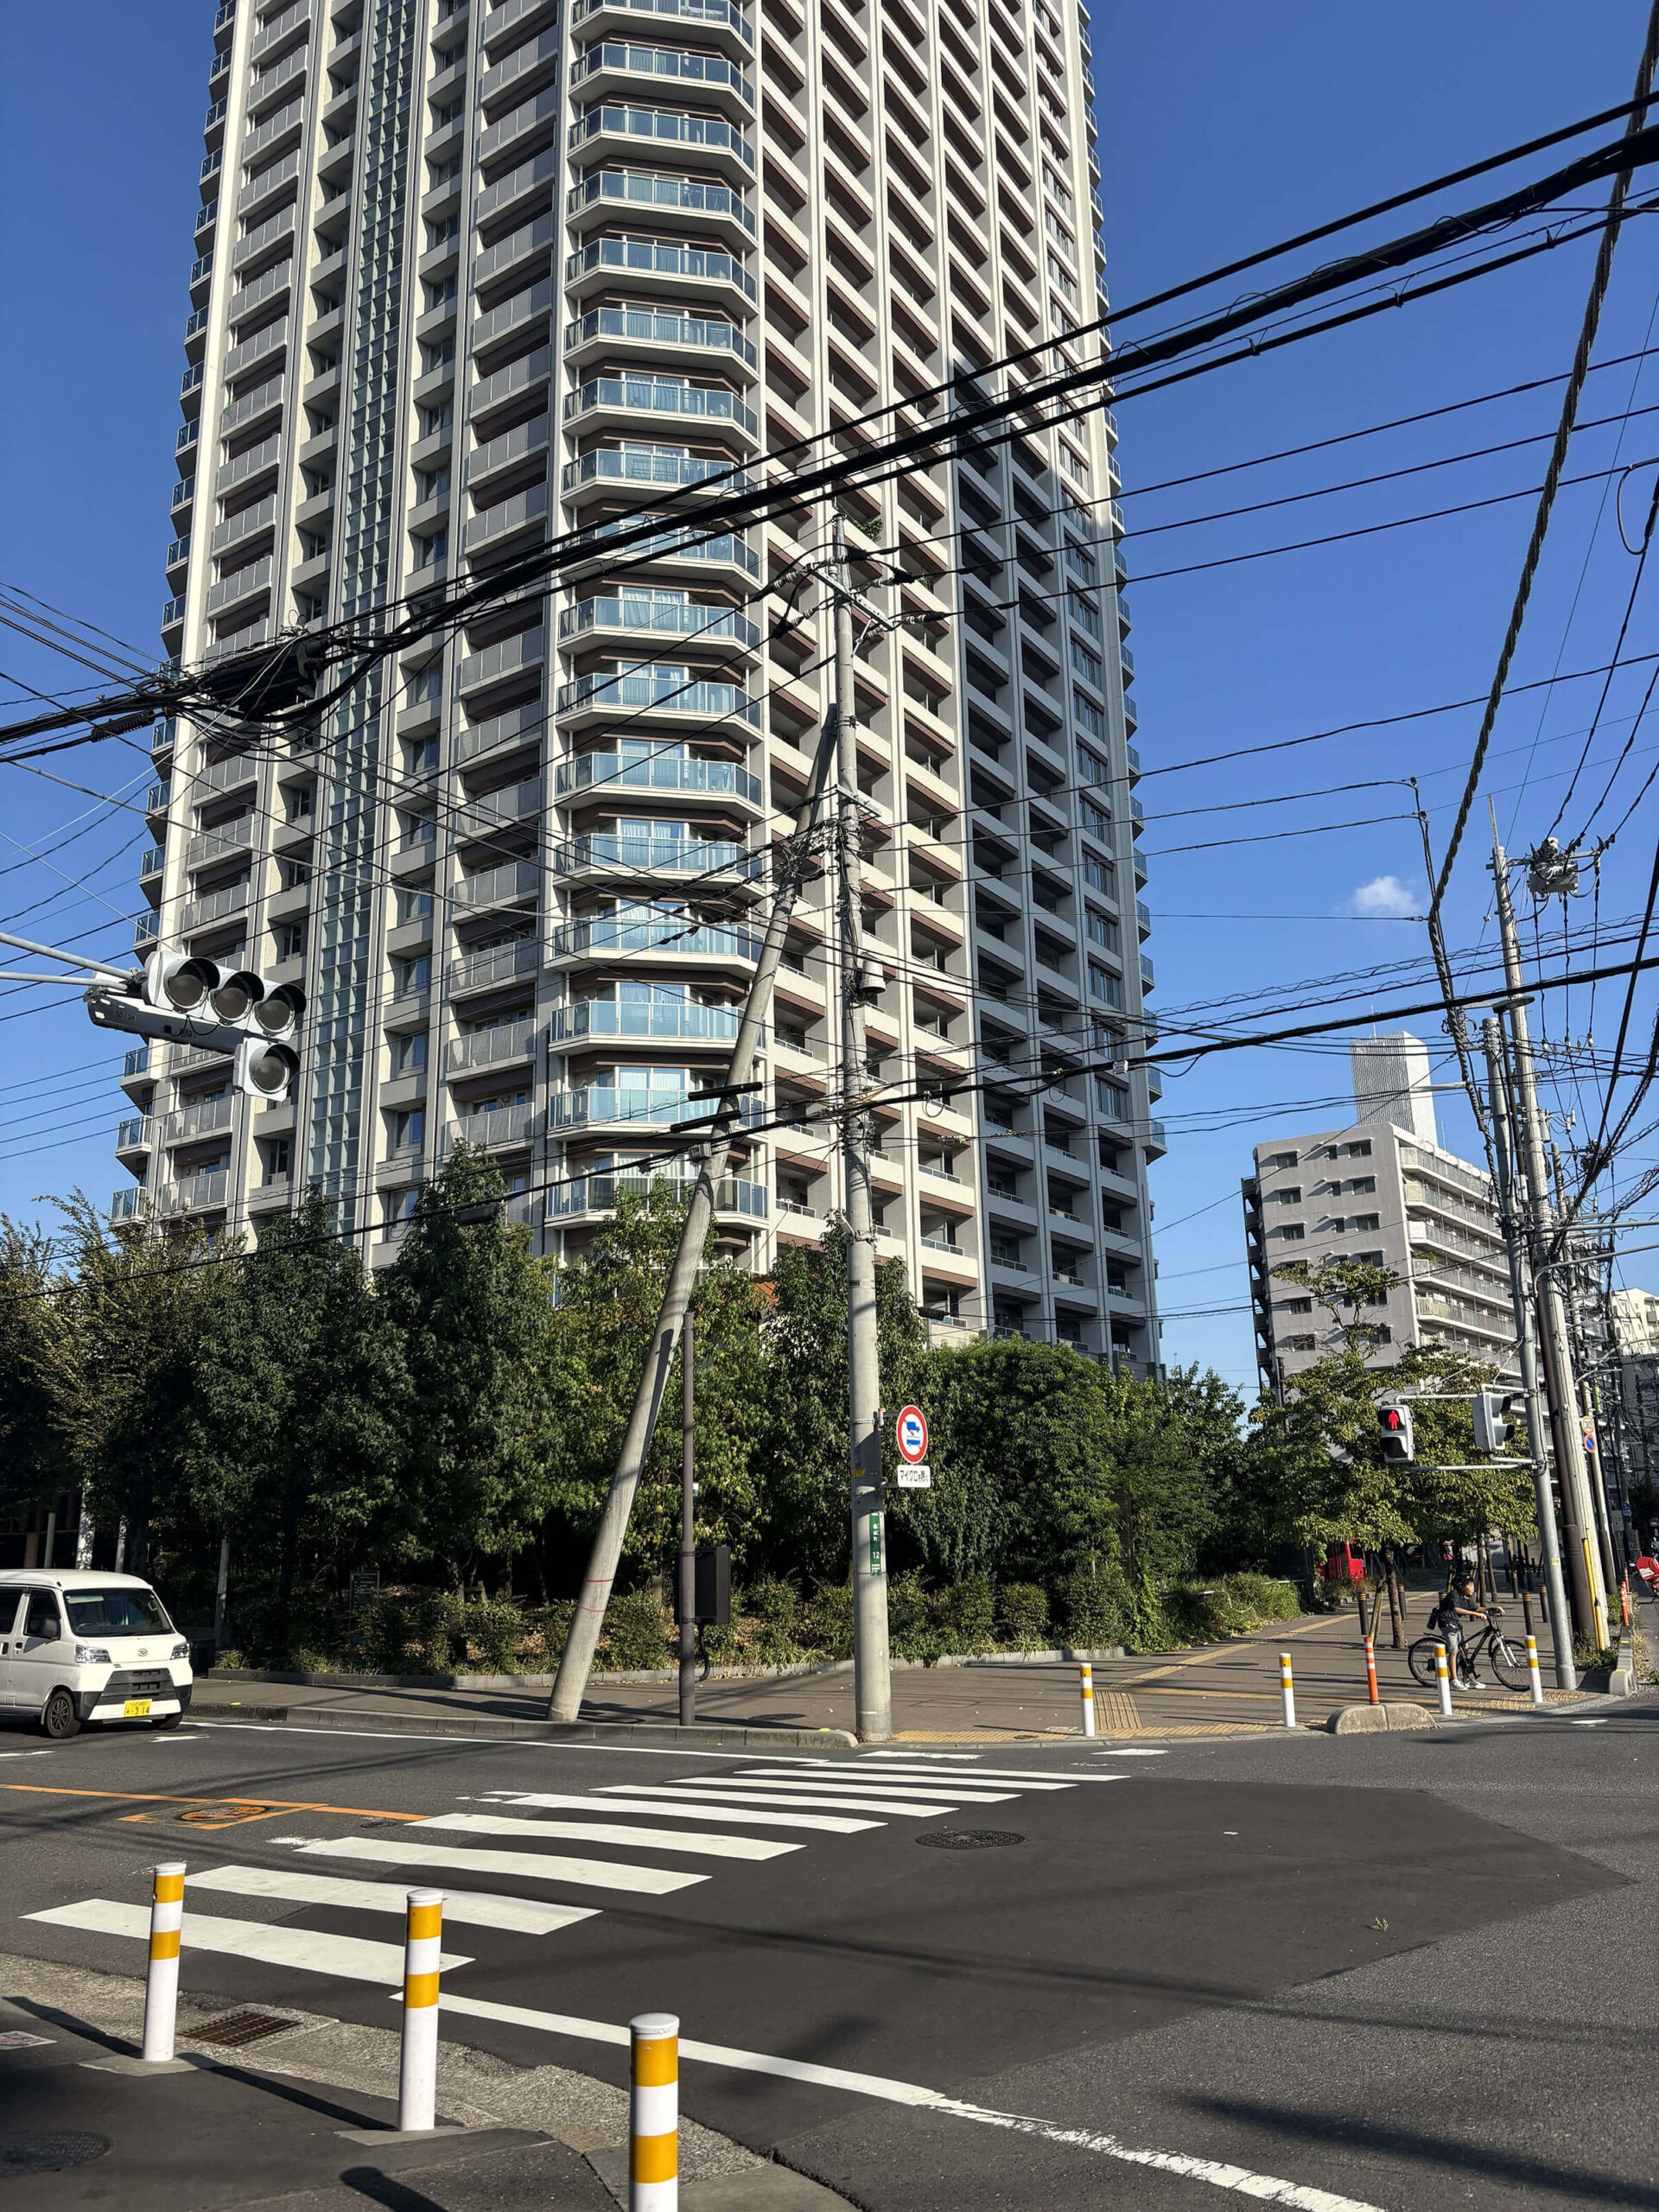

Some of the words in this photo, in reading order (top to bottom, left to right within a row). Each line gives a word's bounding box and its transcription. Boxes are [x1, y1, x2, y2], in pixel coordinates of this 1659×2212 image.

[1585, 1421, 1592, 1429] 30
[899, 1470, 929, 1483] マイクロを除く
